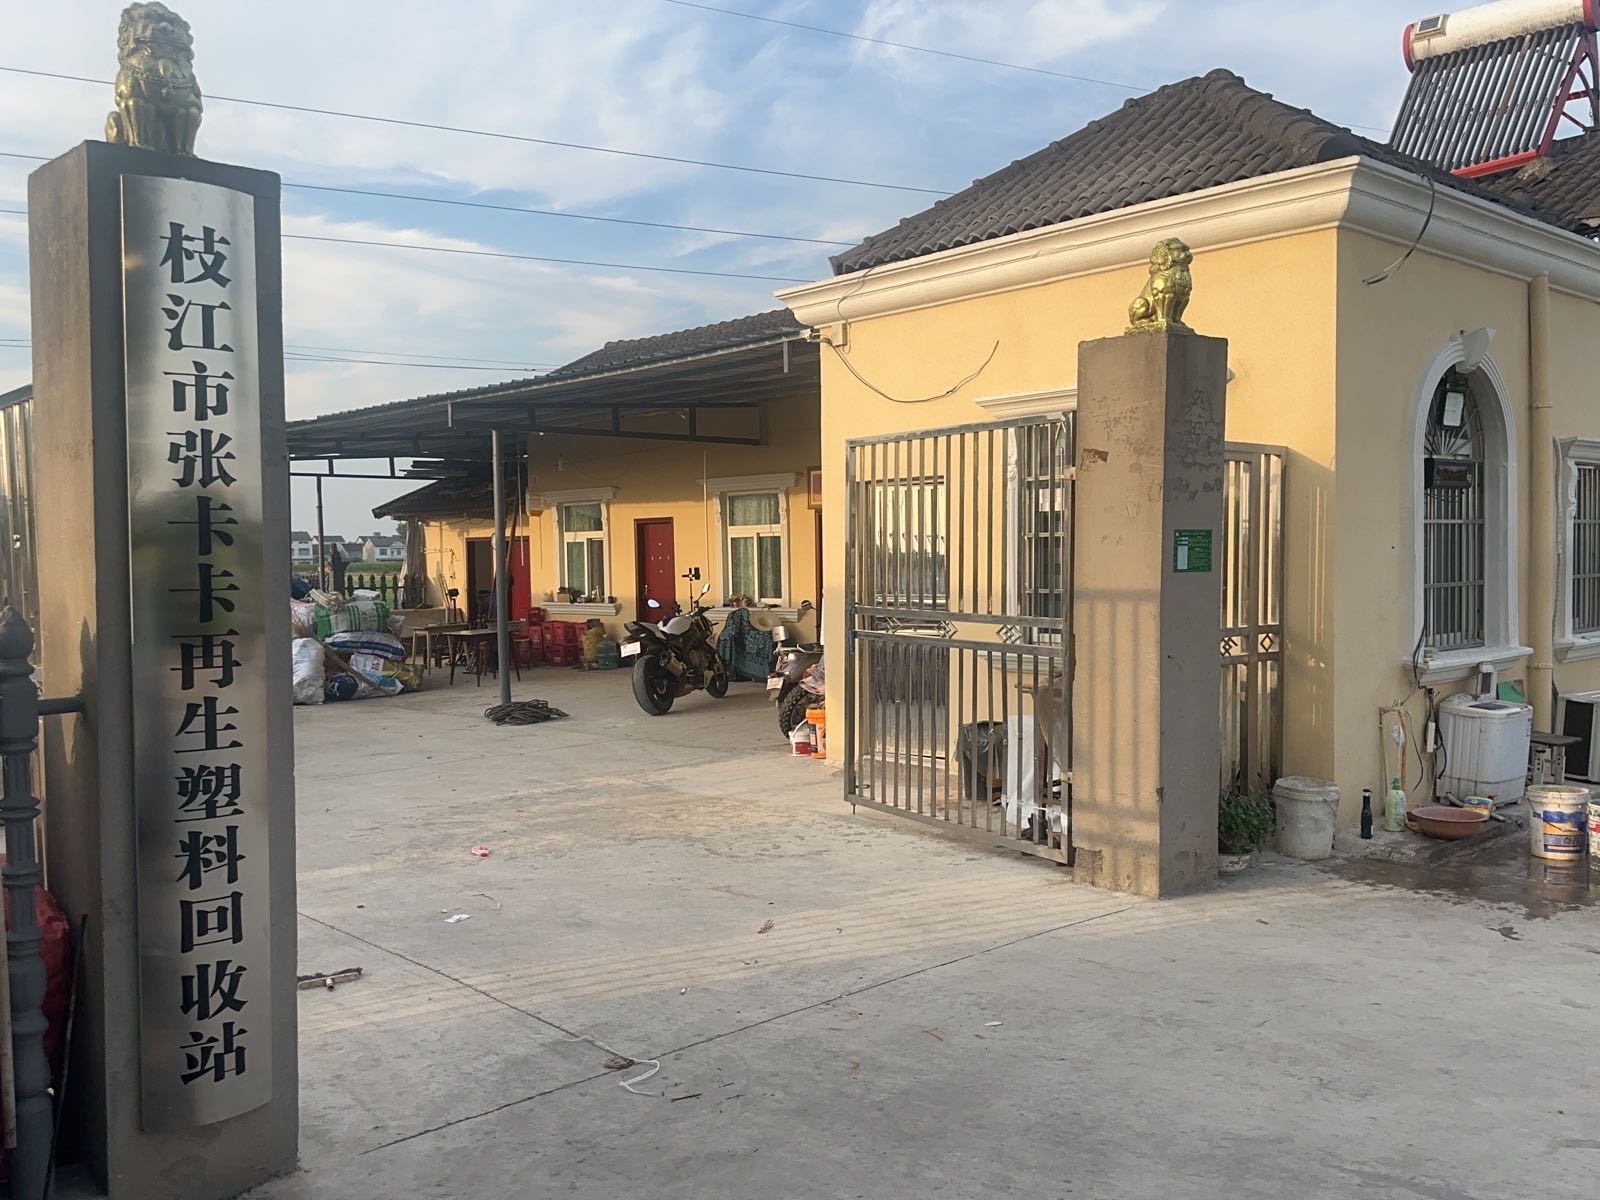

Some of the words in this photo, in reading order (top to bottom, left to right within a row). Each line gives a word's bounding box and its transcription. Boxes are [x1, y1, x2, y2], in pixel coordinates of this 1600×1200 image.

[160, 221, 248, 1085] 枝江市张卡卡再生塑料回收站
